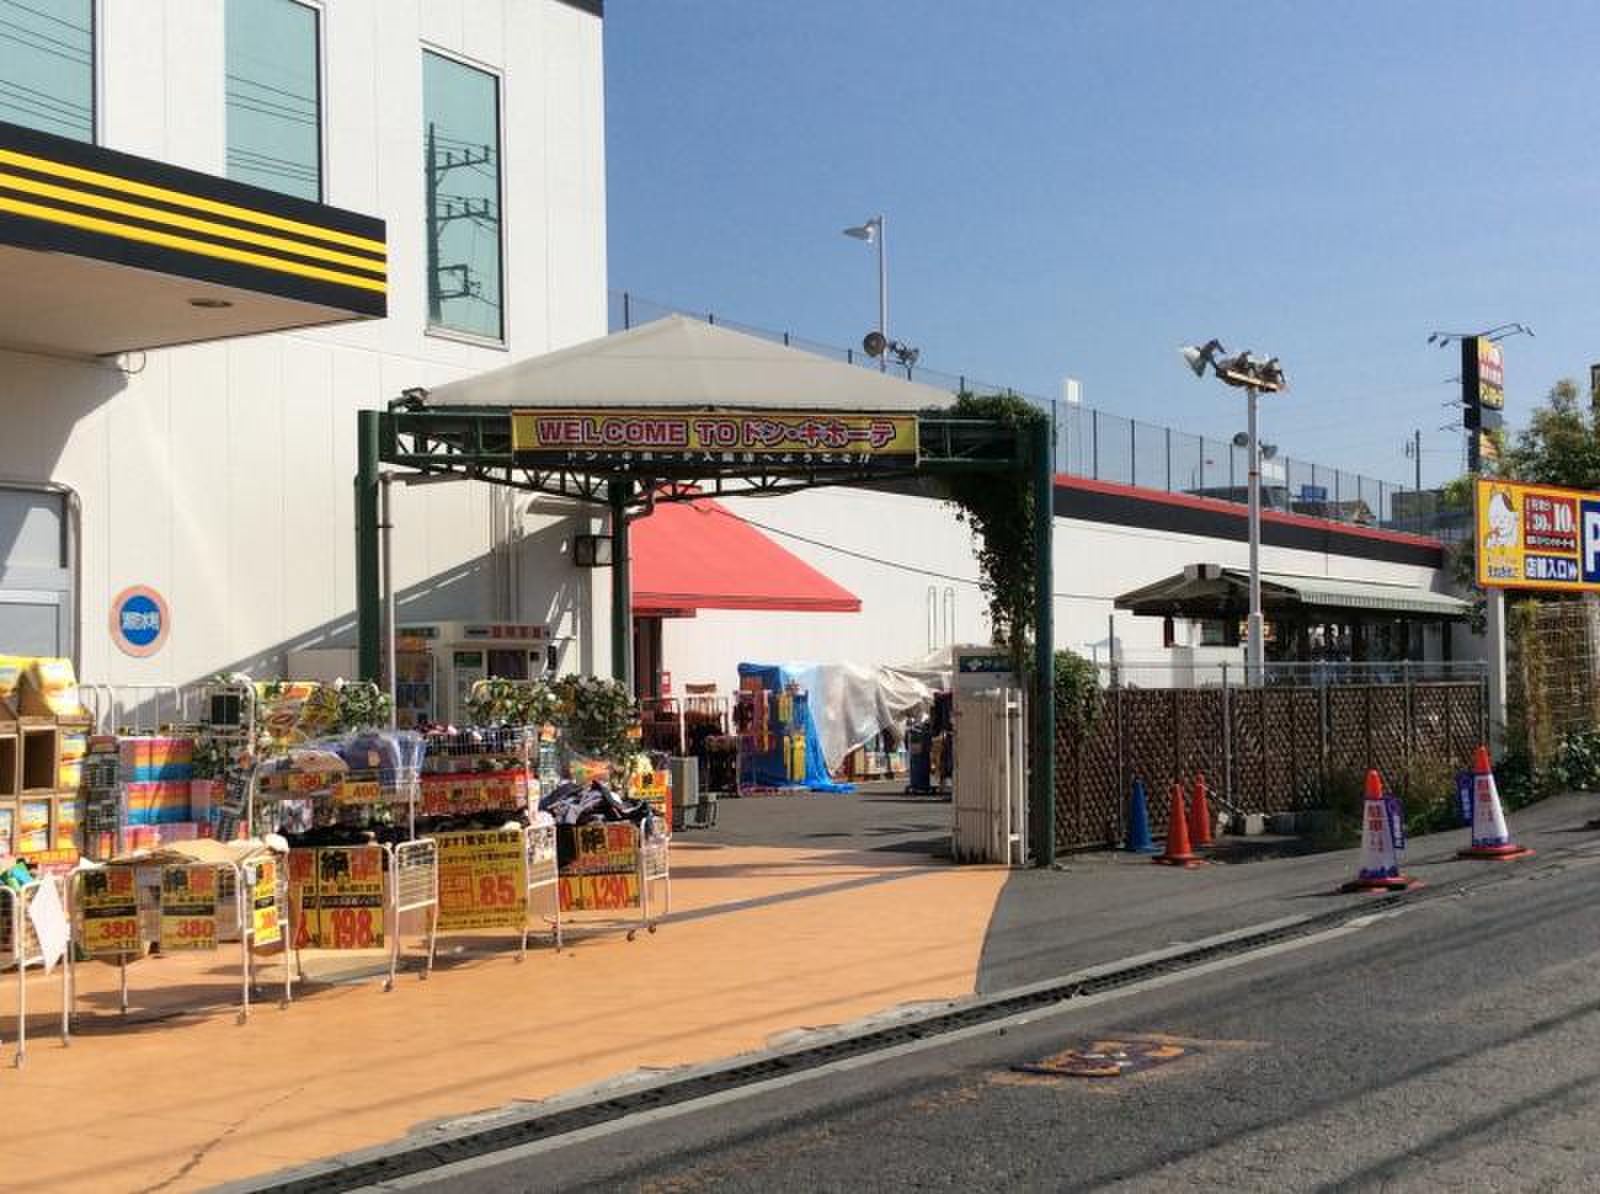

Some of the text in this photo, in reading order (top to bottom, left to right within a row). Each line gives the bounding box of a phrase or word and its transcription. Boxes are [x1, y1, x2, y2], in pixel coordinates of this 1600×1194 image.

[538, 416, 896, 448] WELCOME TO ドン・キホーテ
[479, 875, 516, 907] 85
[102, 919, 137, 938] 380
[176, 919, 213, 938] 380
